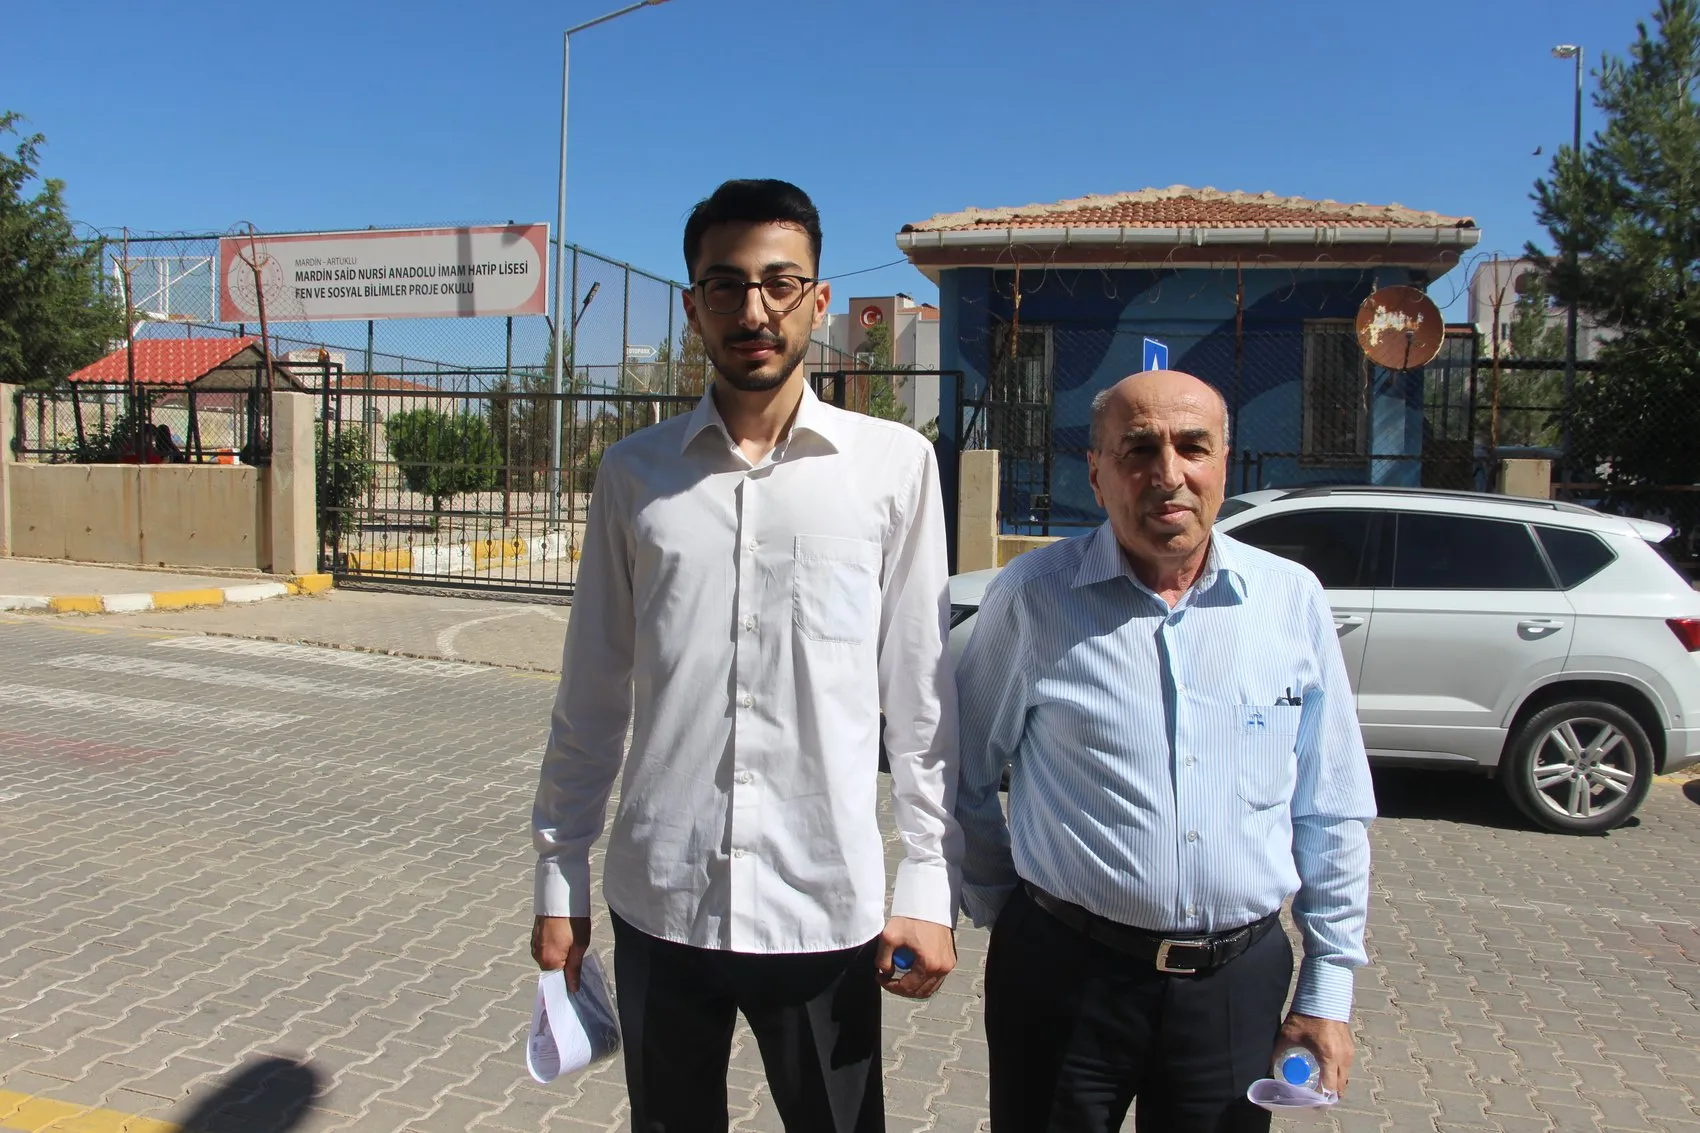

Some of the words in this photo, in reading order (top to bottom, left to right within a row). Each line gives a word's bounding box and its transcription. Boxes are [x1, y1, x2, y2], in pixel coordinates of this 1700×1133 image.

[295, 257, 321, 266] MARDİN
[327, 256, 357, 266] ARTUKLU
[295, 268, 332, 281] MARDİN
[334, 267, 356, 280] SAİD
[358, 265, 386, 280] NURSİ
[388, 265, 436, 279] ANADOLU
[438, 263, 465, 277] İMAM
[468, 261, 497, 275] HATİP
[499, 260, 528, 275] LİSESİ
[295, 287, 312, 299] FEN
[314, 287, 326, 298] VE
[327, 286, 362, 298] SOSYAL
[364, 283, 407, 297] BİLİMLER
[409, 283, 438, 295] PROJE
[441, 282, 474, 295] OKULU
